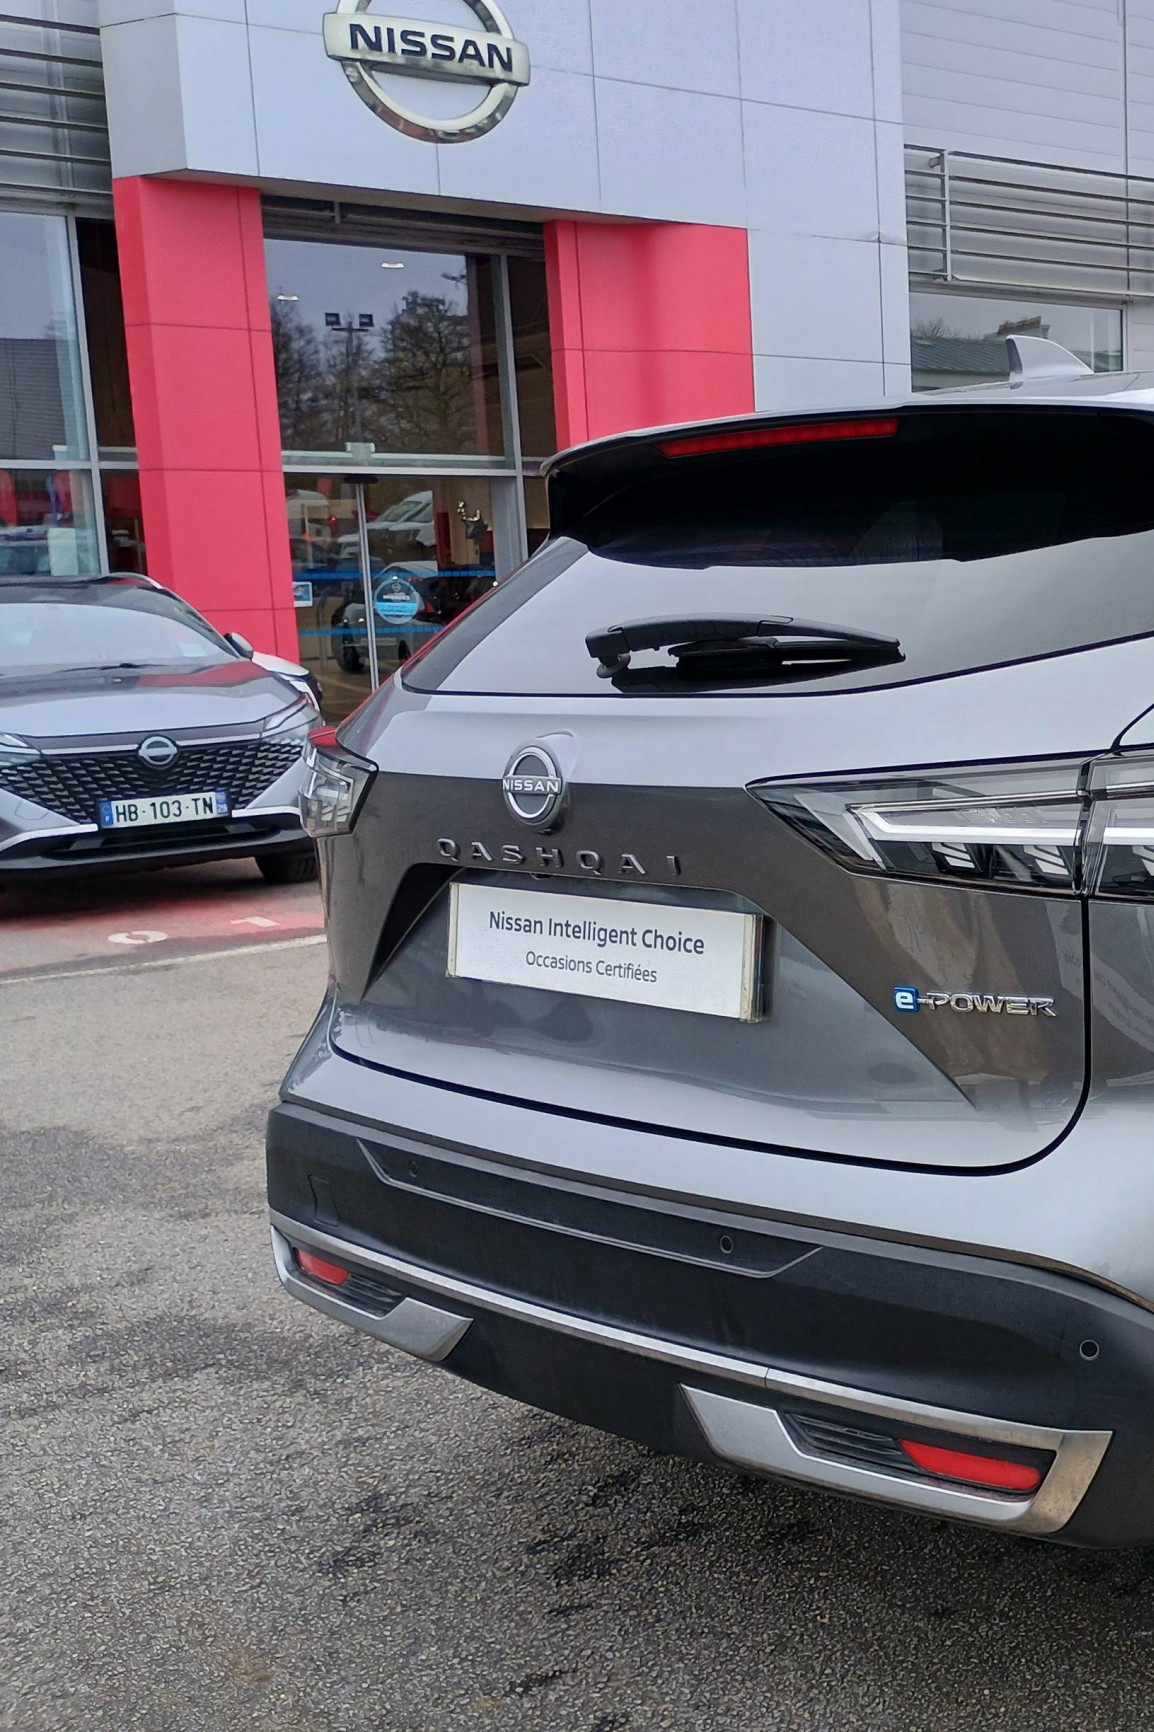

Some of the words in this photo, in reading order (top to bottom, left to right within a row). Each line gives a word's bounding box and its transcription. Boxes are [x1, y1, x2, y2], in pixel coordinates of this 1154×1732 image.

[349, 23, 513, 72] NISSAN
[503, 777, 560, 793] NISSAN
[437, 838, 683, 876] QASHQAI
[489, 911, 543, 935] Nissan
[548, 918, 638, 947] Intelligent
[642, 929, 705, 955] Choice
[526, 951, 593, 974] Occasions
[596, 960, 658, 983] Certifiées
[894, 986, 1057, 1017] e-POWER
